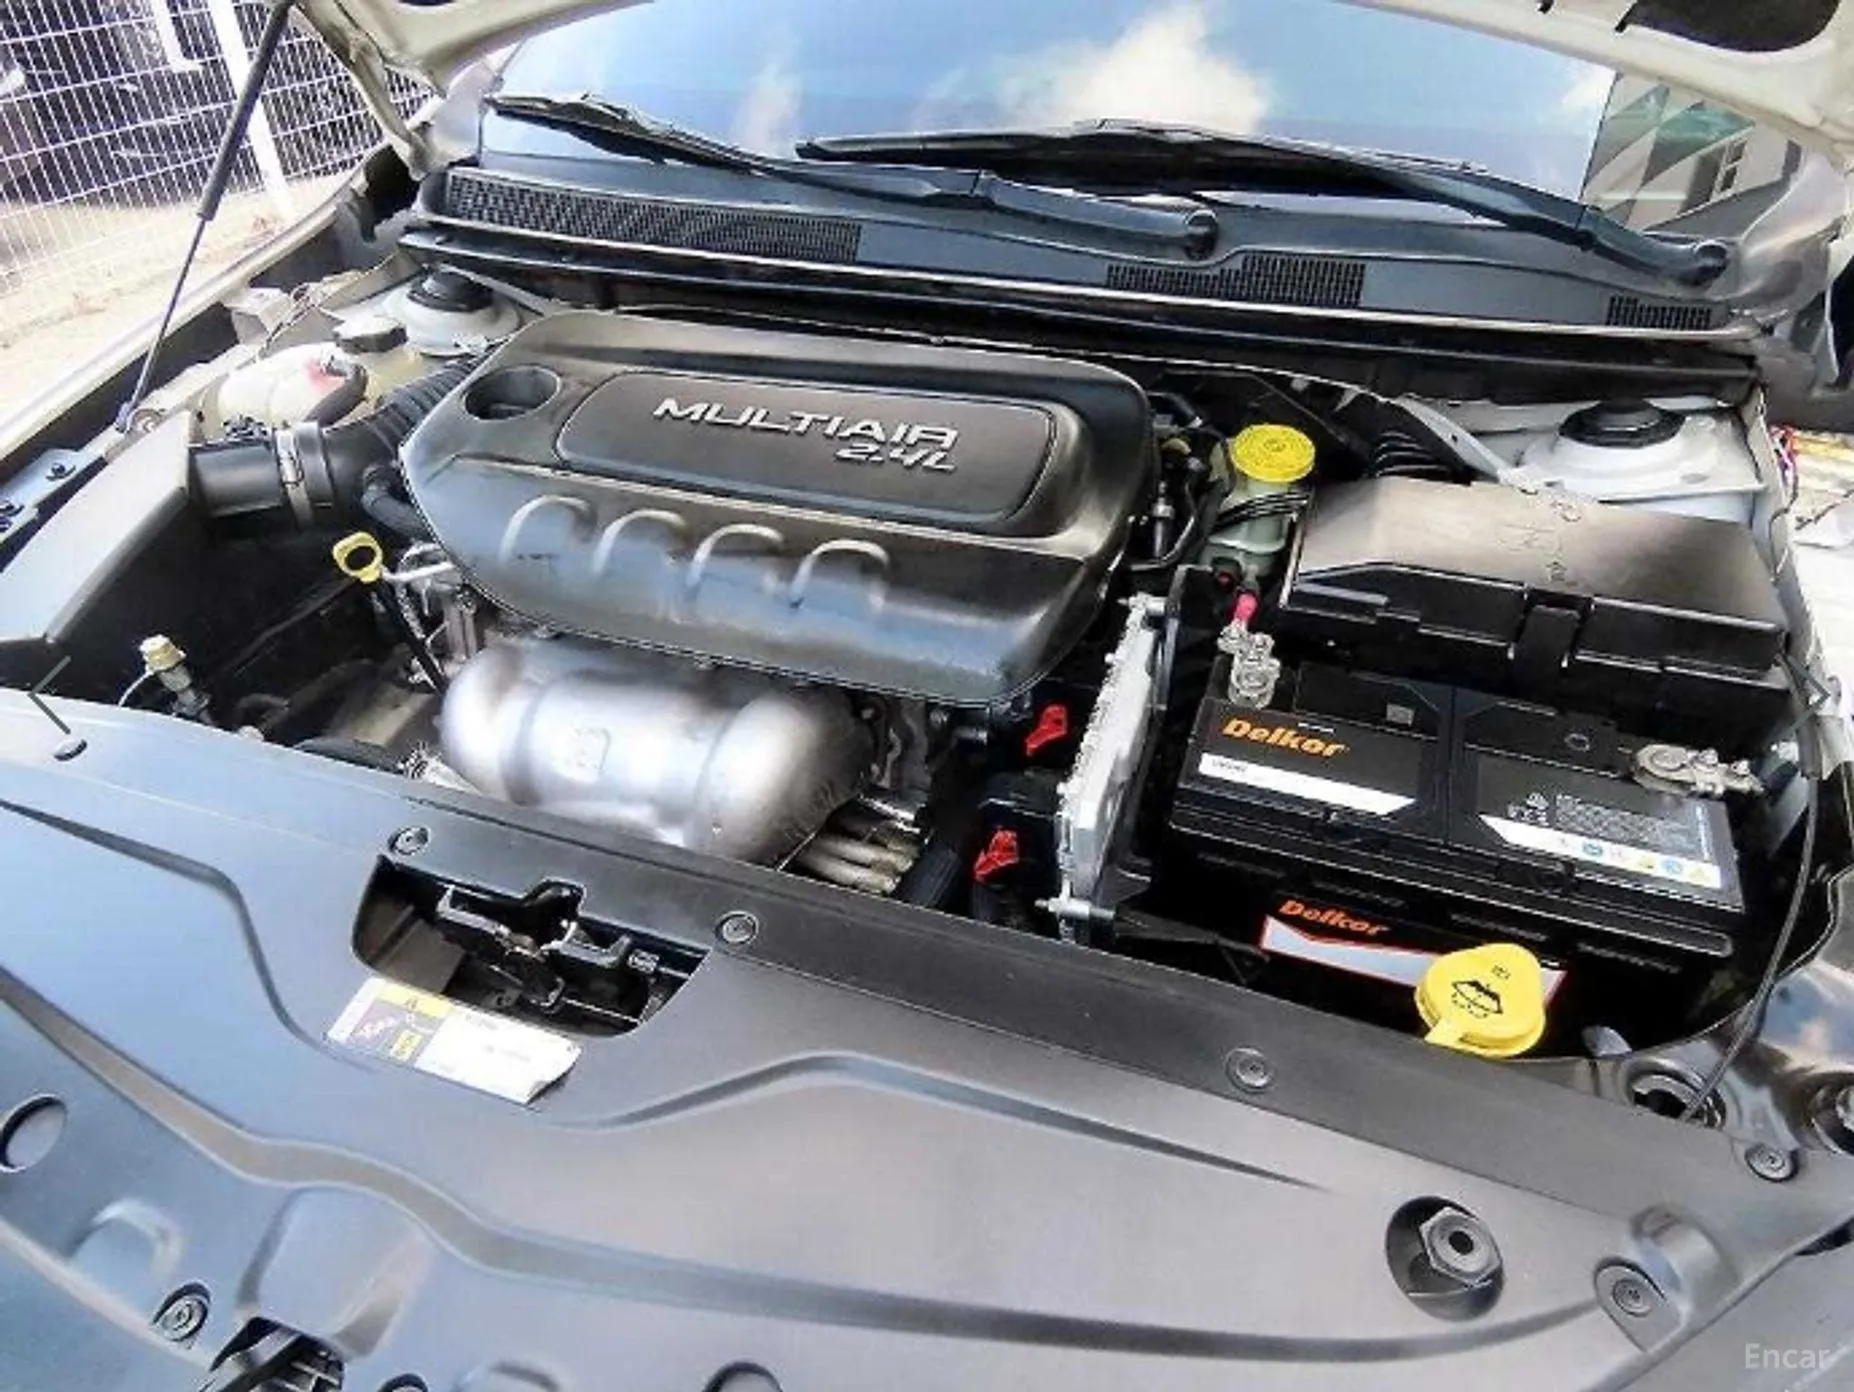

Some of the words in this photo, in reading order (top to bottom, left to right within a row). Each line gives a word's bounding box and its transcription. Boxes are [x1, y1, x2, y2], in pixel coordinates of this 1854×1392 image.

[653, 398, 959, 449] MULTIAIR
[836, 443, 956, 471] 2.4L
[1222, 717, 1349, 757] Delkor
[1279, 899, 1391, 937] Delkor
